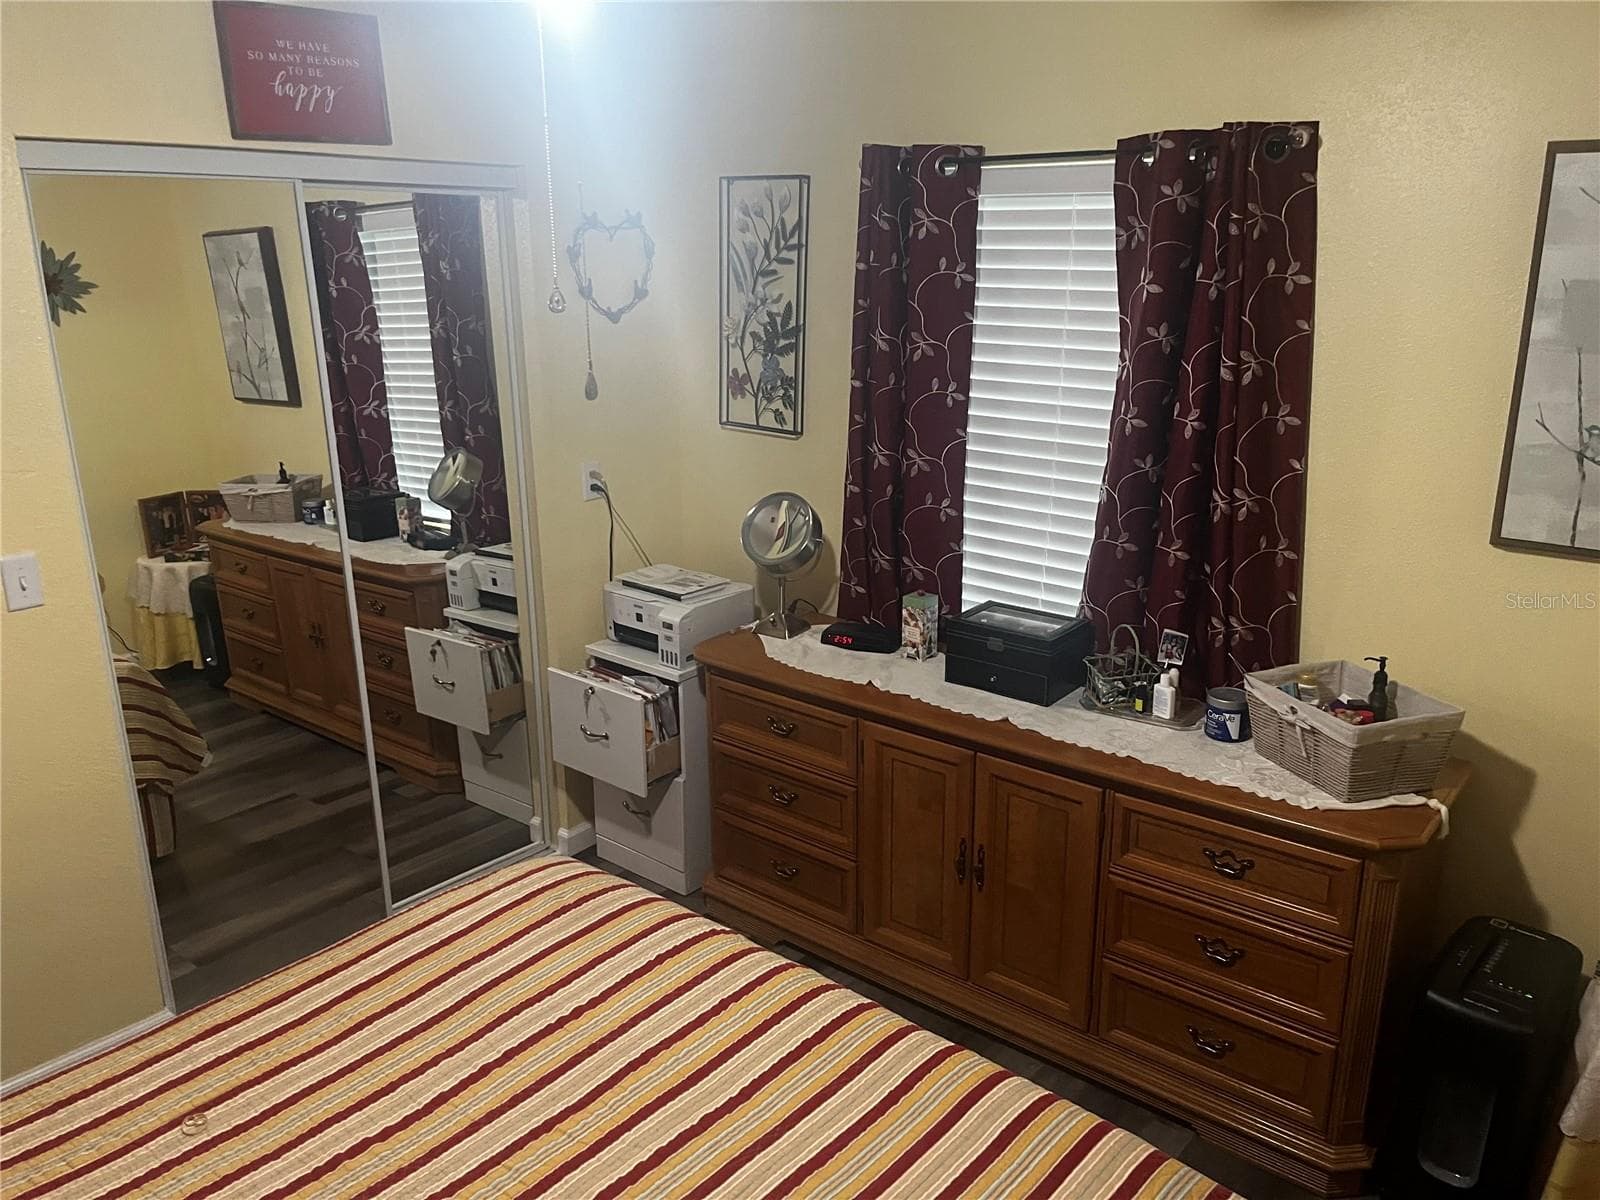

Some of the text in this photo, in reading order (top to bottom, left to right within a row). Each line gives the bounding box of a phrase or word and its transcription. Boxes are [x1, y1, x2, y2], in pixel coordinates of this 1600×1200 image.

[275, 39, 330, 53] WE HAVE
[247, 49, 360, 68] SO MANY REASONS
[287, 65, 324, 78] TO BE
[268, 70, 343, 114] happy
[834, 635, 853, 644] 2:54
